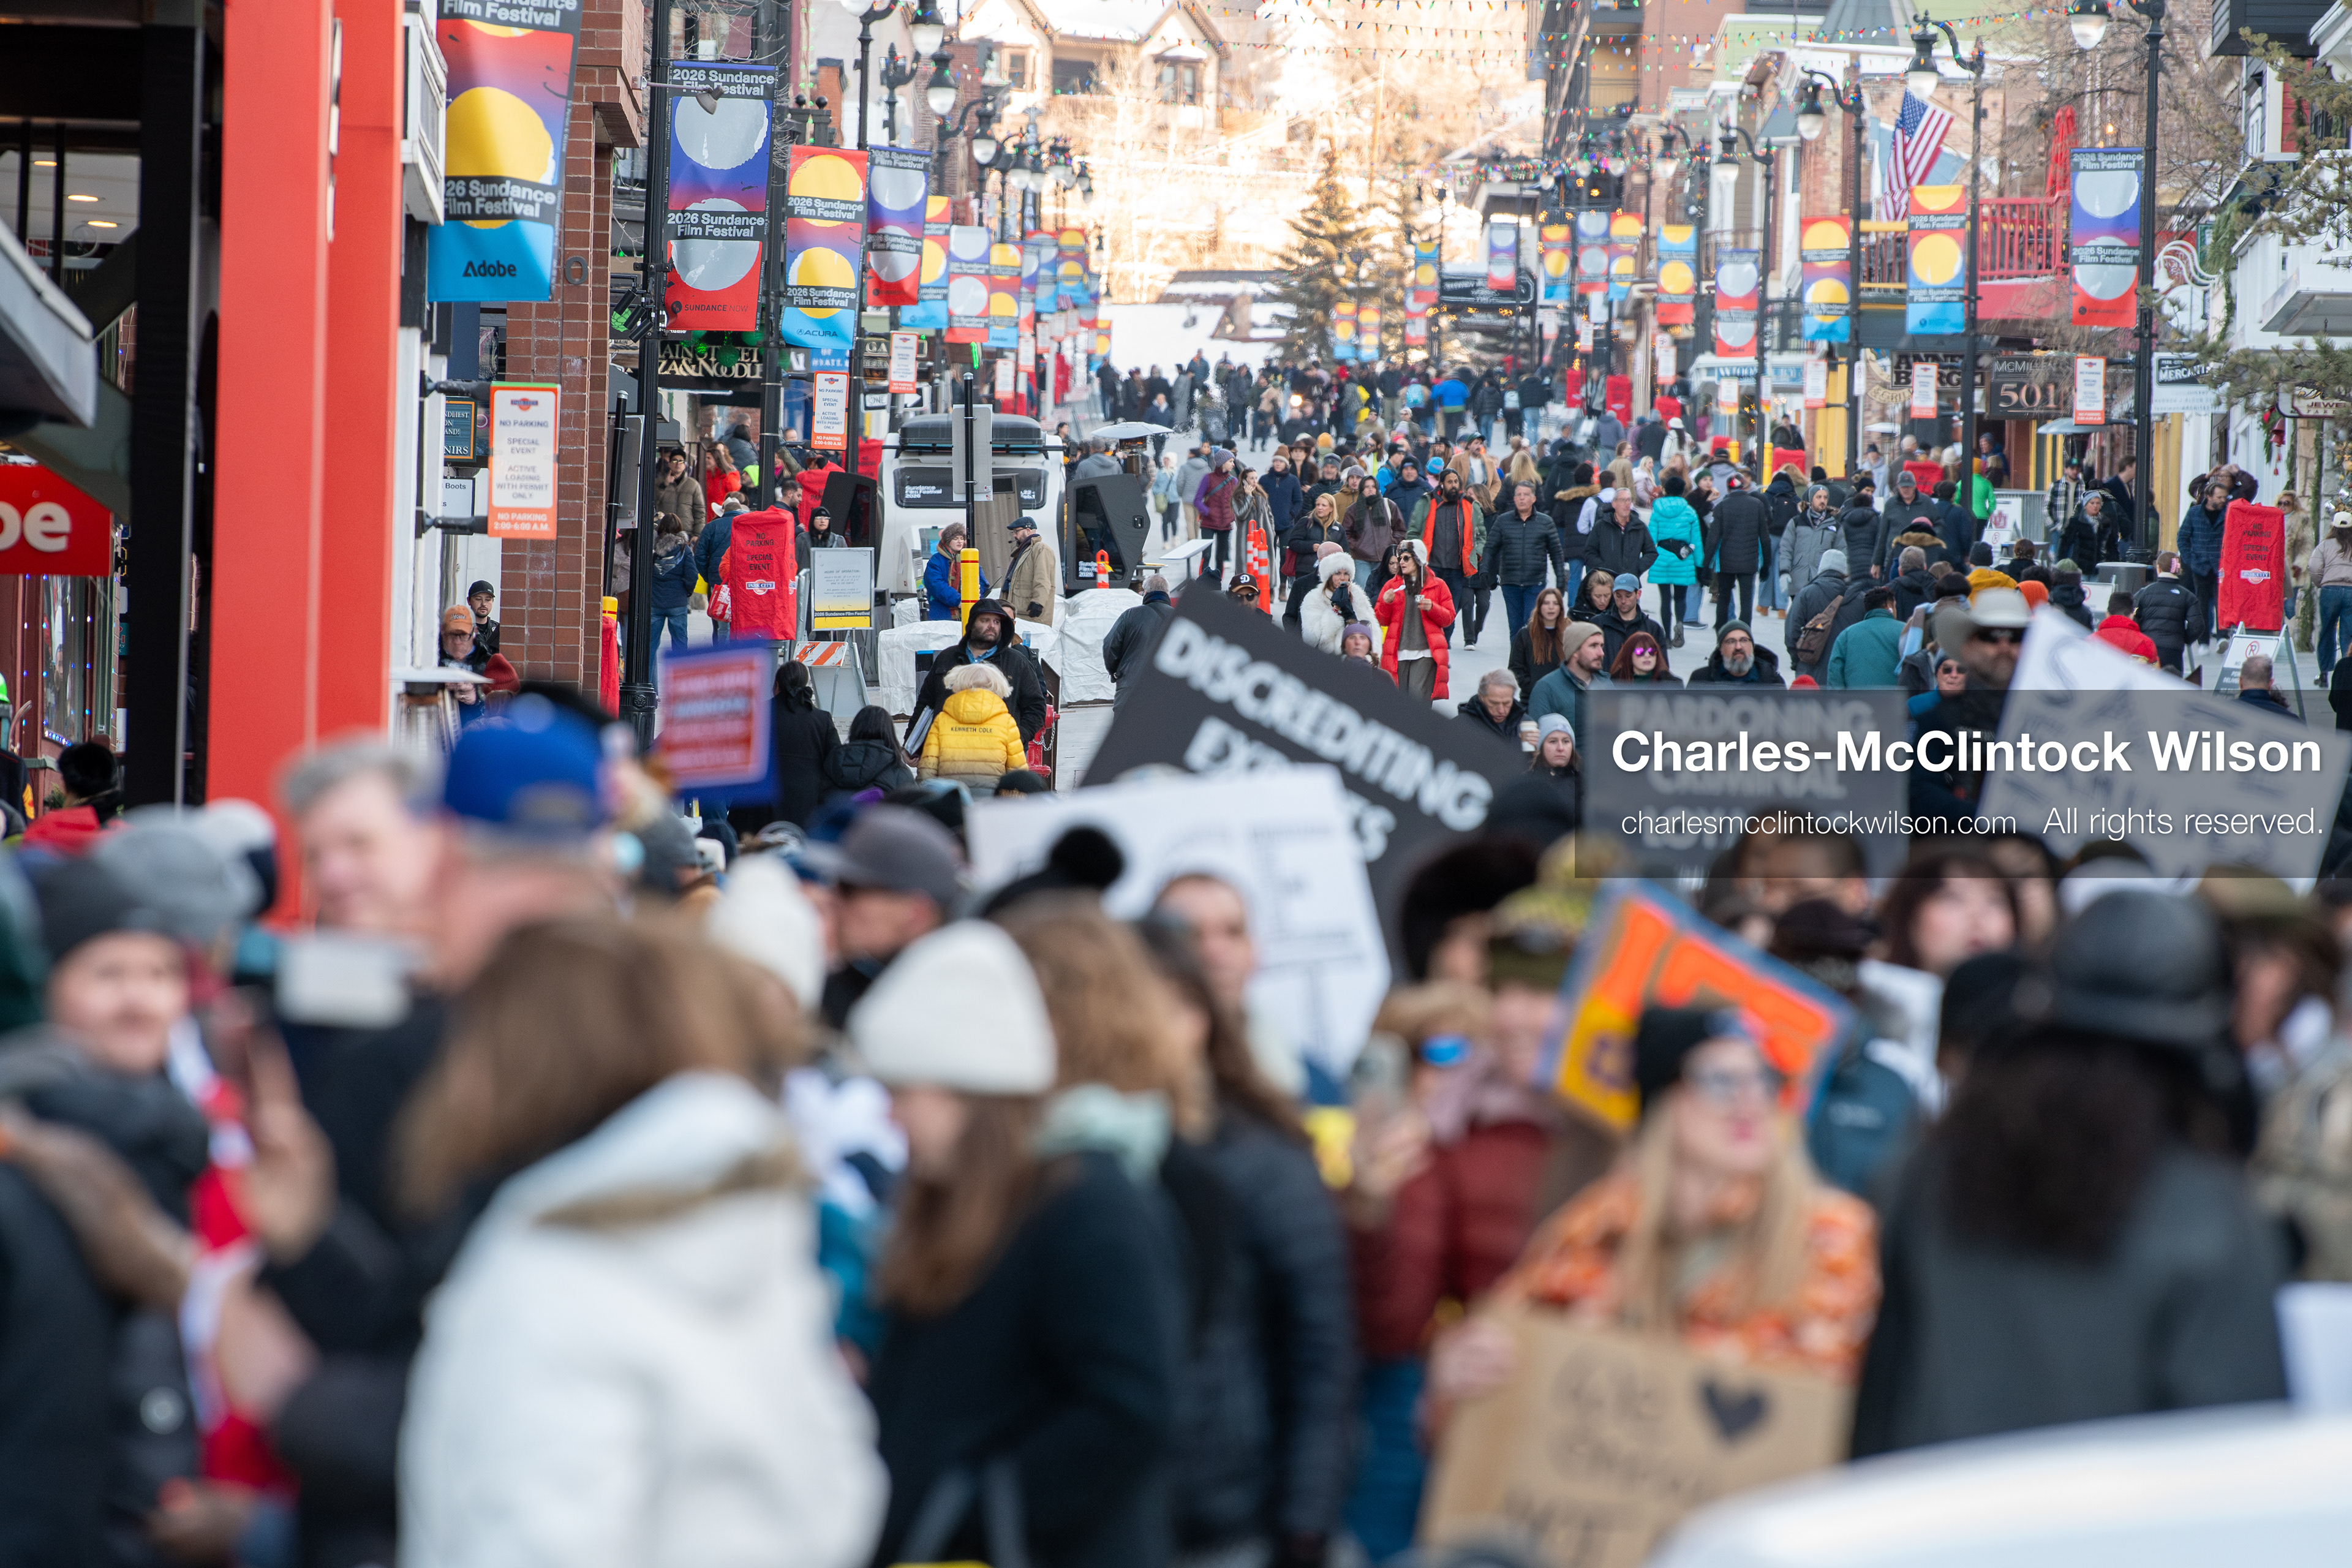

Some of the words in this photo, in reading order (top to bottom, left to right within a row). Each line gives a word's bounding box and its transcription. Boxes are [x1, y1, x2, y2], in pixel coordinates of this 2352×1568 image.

[443, 0, 482, 16] Film
[485, 2, 561, 27] Festival
[673, 69, 706, 81] 2026
[709, 70, 774, 85] Sundance
[446, 180, 467, 198] 26
[469, 179, 557, 205] Sundance
[475, 197, 540, 217] Festival
[788, 197, 813, 206] 2026
[813, 199, 864, 211] Sundance
[667, 213, 699, 224] 2026
[701, 214, 764, 226] Sundance
[794, 206, 816, 216] Film
[817, 208, 856, 219] Festival
[677, 225, 702, 236] Film
[705, 225, 754, 236] Festival
[462, 260, 516, 277] Adobe
[787, 287, 808, 296] 2026
[809, 288, 856, 299] Sundance
[793, 296, 812, 306] Film
[812, 297, 848, 307] Festival
[1999, 383, 2057, 408] 501
[443, 446, 469, 455] NIRS
[497, 512, 510, 521] NO
[511, 513, 547, 521] PARKING
[1154, 616, 1494, 832] DISCREDITING
[1618, 694, 1878, 741] PARDONING
